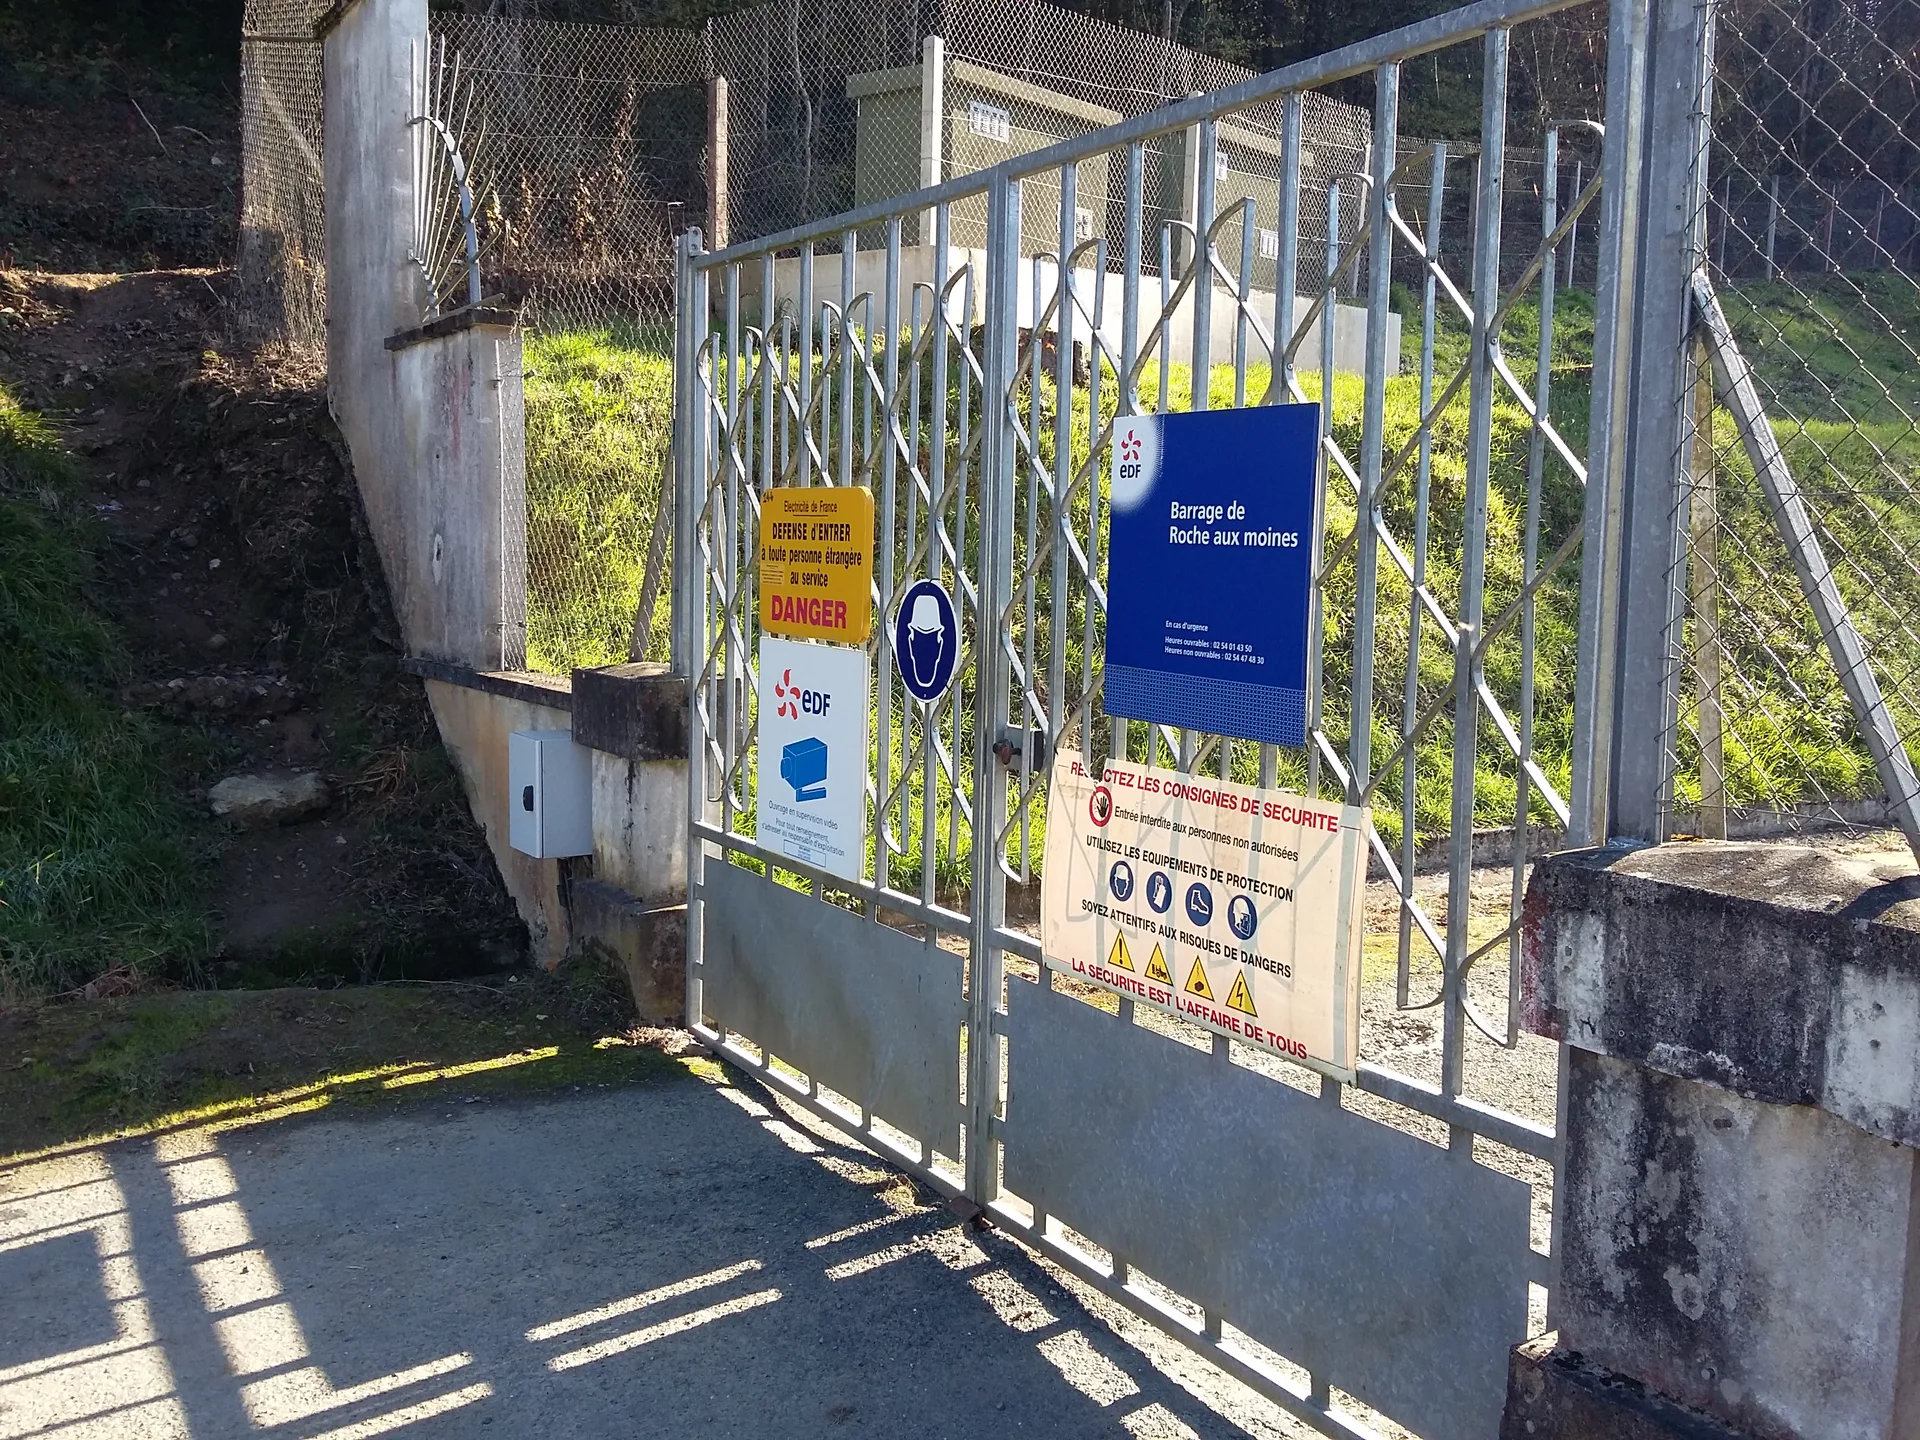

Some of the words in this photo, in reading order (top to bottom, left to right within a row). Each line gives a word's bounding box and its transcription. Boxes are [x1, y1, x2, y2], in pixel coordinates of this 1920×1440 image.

[811, 501, 818, 513] de
[820, 500, 837, 513] France
[1171, 501, 1223, 524] Barrage
[1227, 500, 1245, 520] de
[772, 523, 807, 540] DEFENSE
[811, 523, 851, 541] d'ENTRER
[1169, 525, 1210, 545] Roche
[1213, 531, 1240, 546] aux
[1244, 527, 1298, 548] moines
[761, 544, 766, 560] à
[769, 545, 786, 562] toute
[789, 549, 822, 565] personne
[825, 546, 862, 569] étrangère
[790, 571, 799, 585] au
[801, 568, 828, 587] service
[771, 595, 847, 629] DANGER
[1165, 620, 1172, 628] En
[1182, 622, 1208, 632] d'urgence
[1164, 636, 1183, 644] Heures
[1183, 639, 1210, 648] ouvrables
[1213, 641, 1220, 649] 02
[1220, 642, 1228, 650] 54
[1228, 643, 1236, 651] 01
[1236, 644, 1244, 652] 43
[1245, 644, 1252, 653] 50
[1164, 645, 1183, 655] Heures
[1194, 650, 1221, 659] ouvrables
[1224, 652, 1232, 661] 02
[1232, 653, 1240, 661] 54
[1240, 654, 1248, 662] 47
[1070, 761, 1135, 788] RECTEZ
[1137, 777, 1160, 793] LES
[1163, 781, 1238, 810] CONSIGNES
[1241, 797, 1260, 816] DE
[1263, 802, 1338, 833] SECURITE
[768, 800, 788, 816] Ouvrage
[789, 808, 795, 816] en
[796, 810, 823, 825] supervision
[775, 818, 785, 827] Pour
[786, 822, 796, 831] tout
[1114, 806, 1138, 822] Entrée
[1140, 811, 1171, 830] interdite
[1172, 822, 1187, 834] aux
[1188, 824, 1231, 845] personnes
[1233, 837, 1249, 849] non
[1251, 840, 1299, 862] autorisées
[1086, 835, 1122, 855] UTILISEZ
[1124, 844, 1140, 860] LES
[1143, 850, 1208, 878] EQUIPEMENTS
[1210, 868, 1223, 883] DE
[1226, 873, 1293, 902] PROTECTION
[1081, 899, 1109, 917] SOYEZ
[1110, 909, 1156, 934] ATTENTIFS
[1158, 924, 1177, 941] AUX
[1180, 931, 1221, 955] RISQUES
[1224, 945, 1238, 961] DE
[1241, 950, 1291, 978] DANGERS
[1071, 958, 1086, 975] LA
[1088, 964, 1146, 998] SECURITE
[1149, 986, 1172, 1007] EST
[1176, 995, 1240, 1035] L'AFFAIRE
[1244, 1022, 1264, 1043] DE
[1267, 1030, 1307, 1060] TOUS
